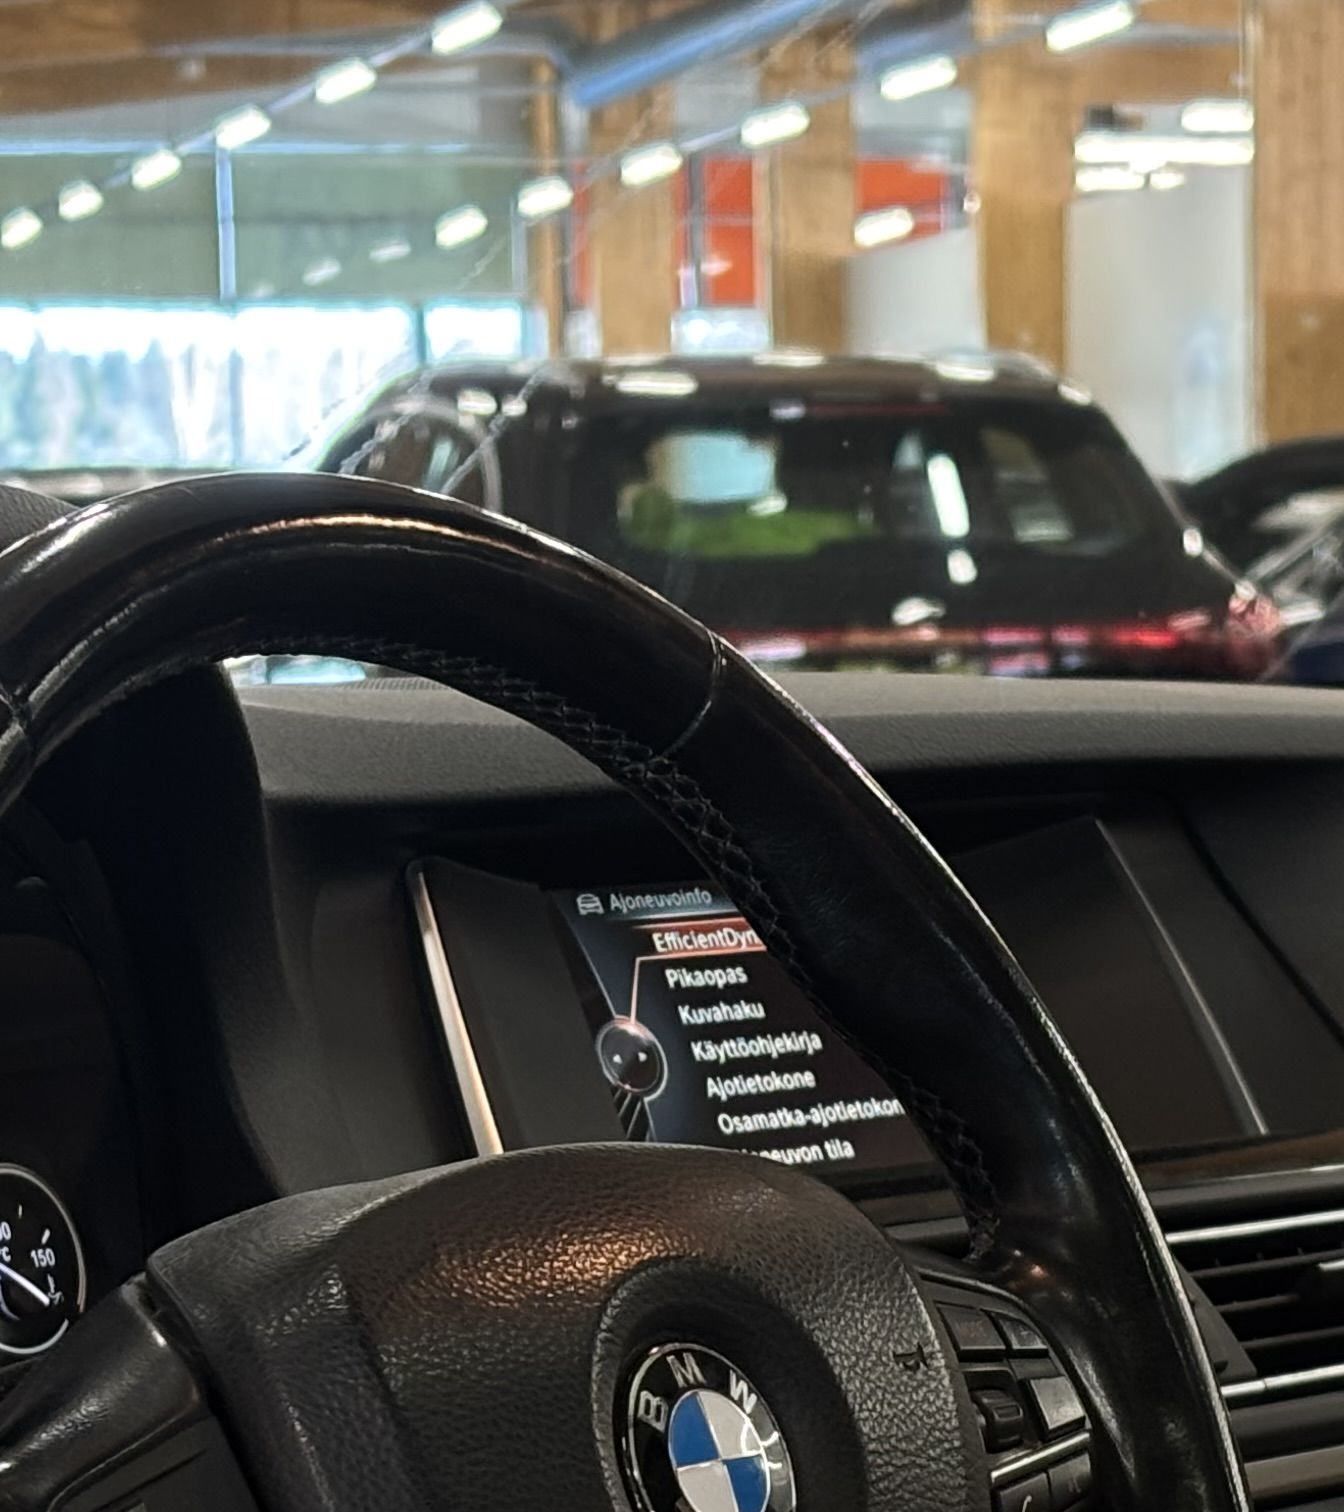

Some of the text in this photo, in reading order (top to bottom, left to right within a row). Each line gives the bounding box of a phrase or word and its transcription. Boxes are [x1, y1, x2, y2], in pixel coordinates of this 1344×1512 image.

[609, 888, 712, 914] Ajoneuvoinfo
[664, 965, 749, 990] Pikaopas
[678, 999, 766, 1025] Kuvahaku
[690, 1030, 823, 1064] Käyttöohjekirja
[707, 1070, 816, 1102] Ajotietokone
[717, 1097, 905, 1135] Osamatka-ajotietokon
[824, 1138, 855, 1160] tila
[31, 1247, 56, 1268] 150
[637, 1352, 757, 1433] BMW
